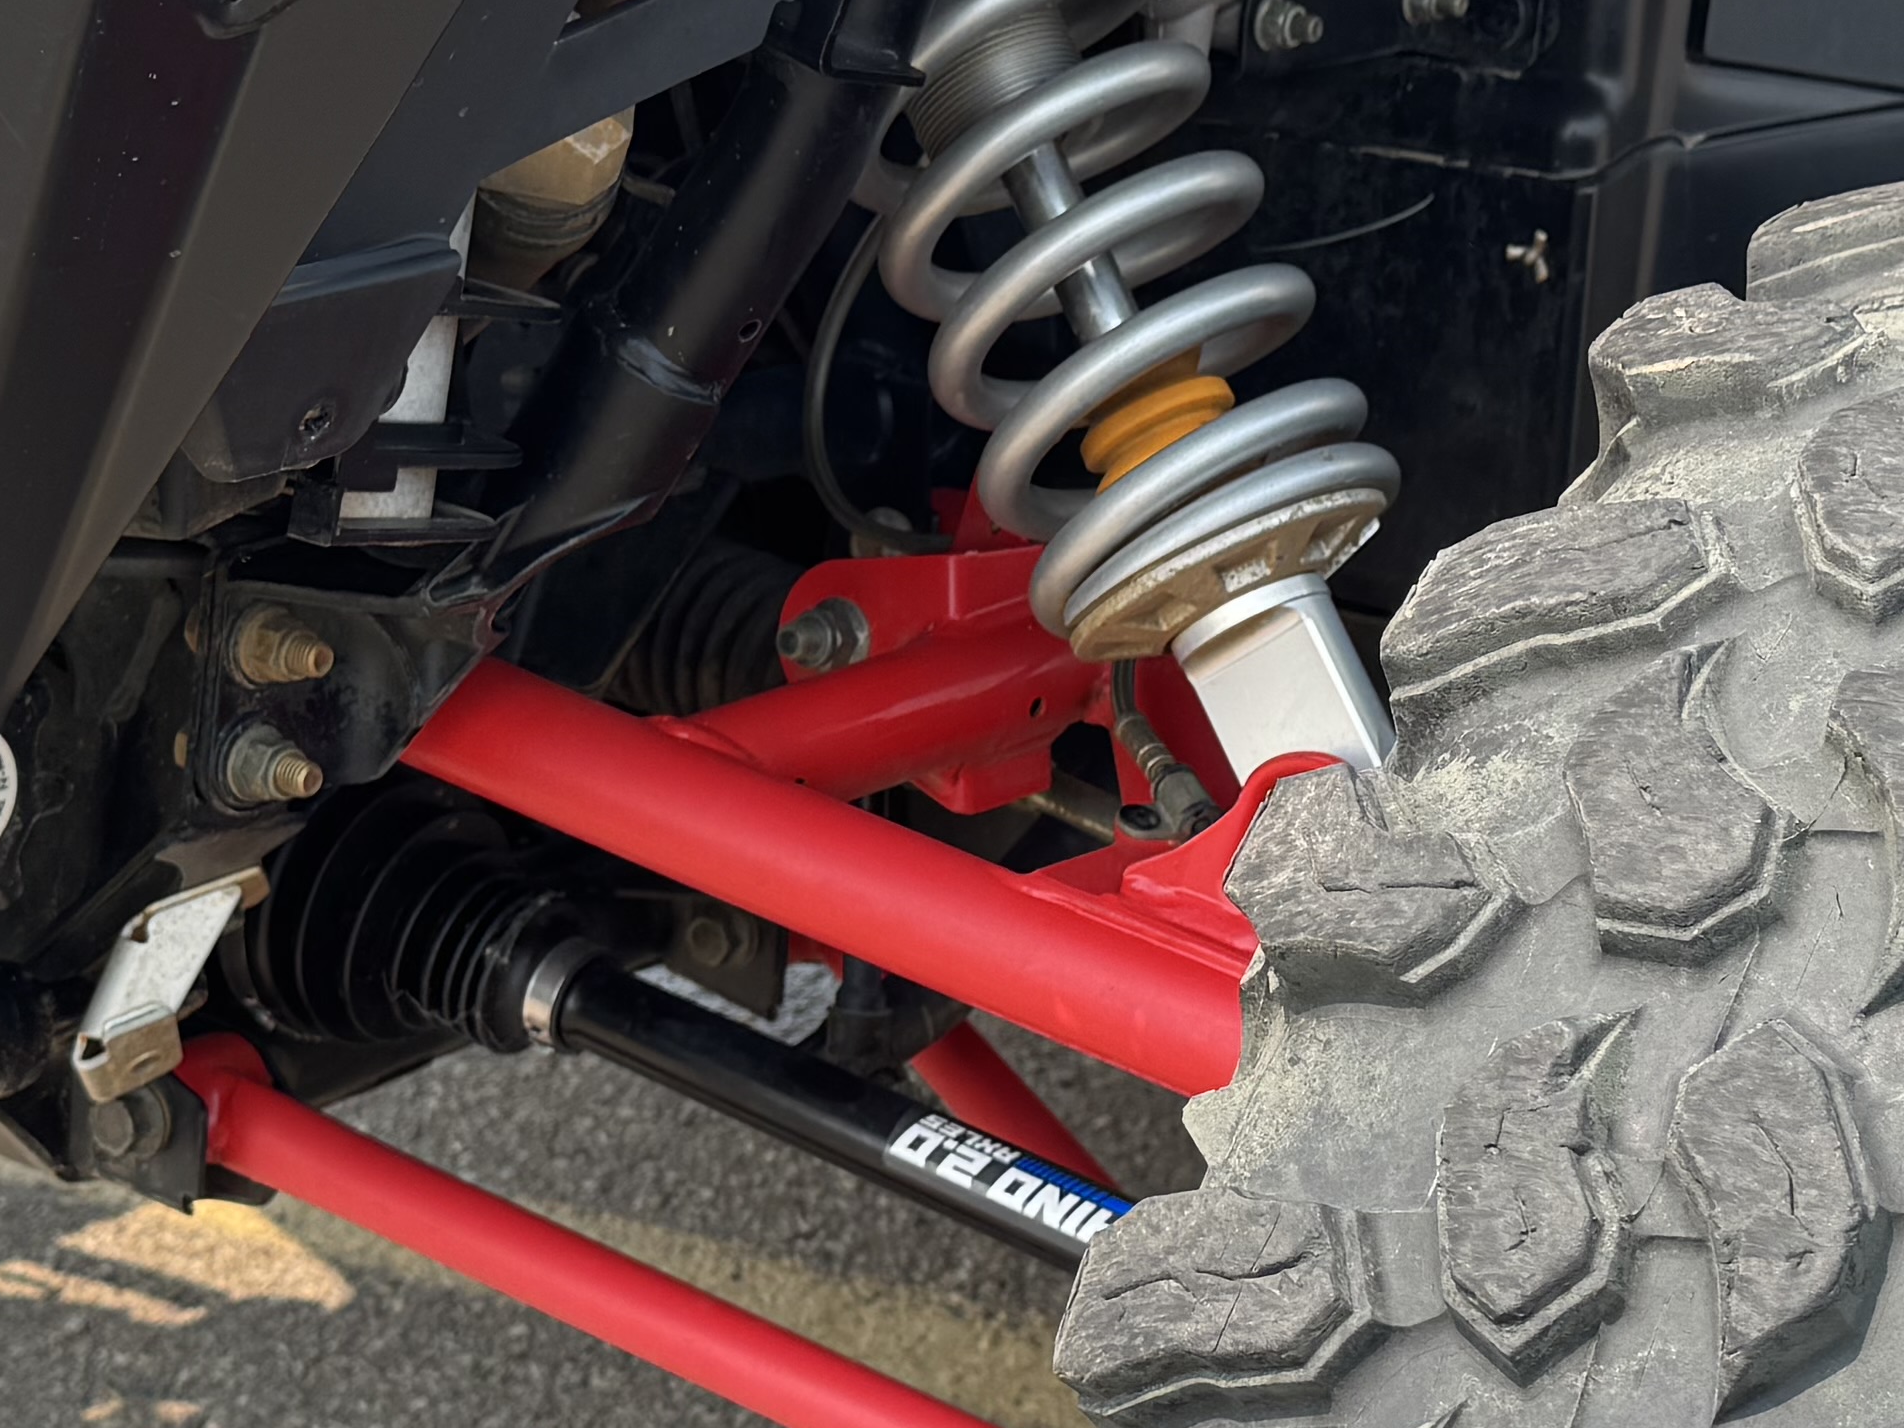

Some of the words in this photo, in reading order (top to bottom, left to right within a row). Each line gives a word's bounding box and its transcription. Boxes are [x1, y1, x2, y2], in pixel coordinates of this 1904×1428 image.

[889, 1123, 994, 1190] 2.0
[919, 1113, 1023, 1164] AXLES
[986, 1167, 1114, 1244] HINO
